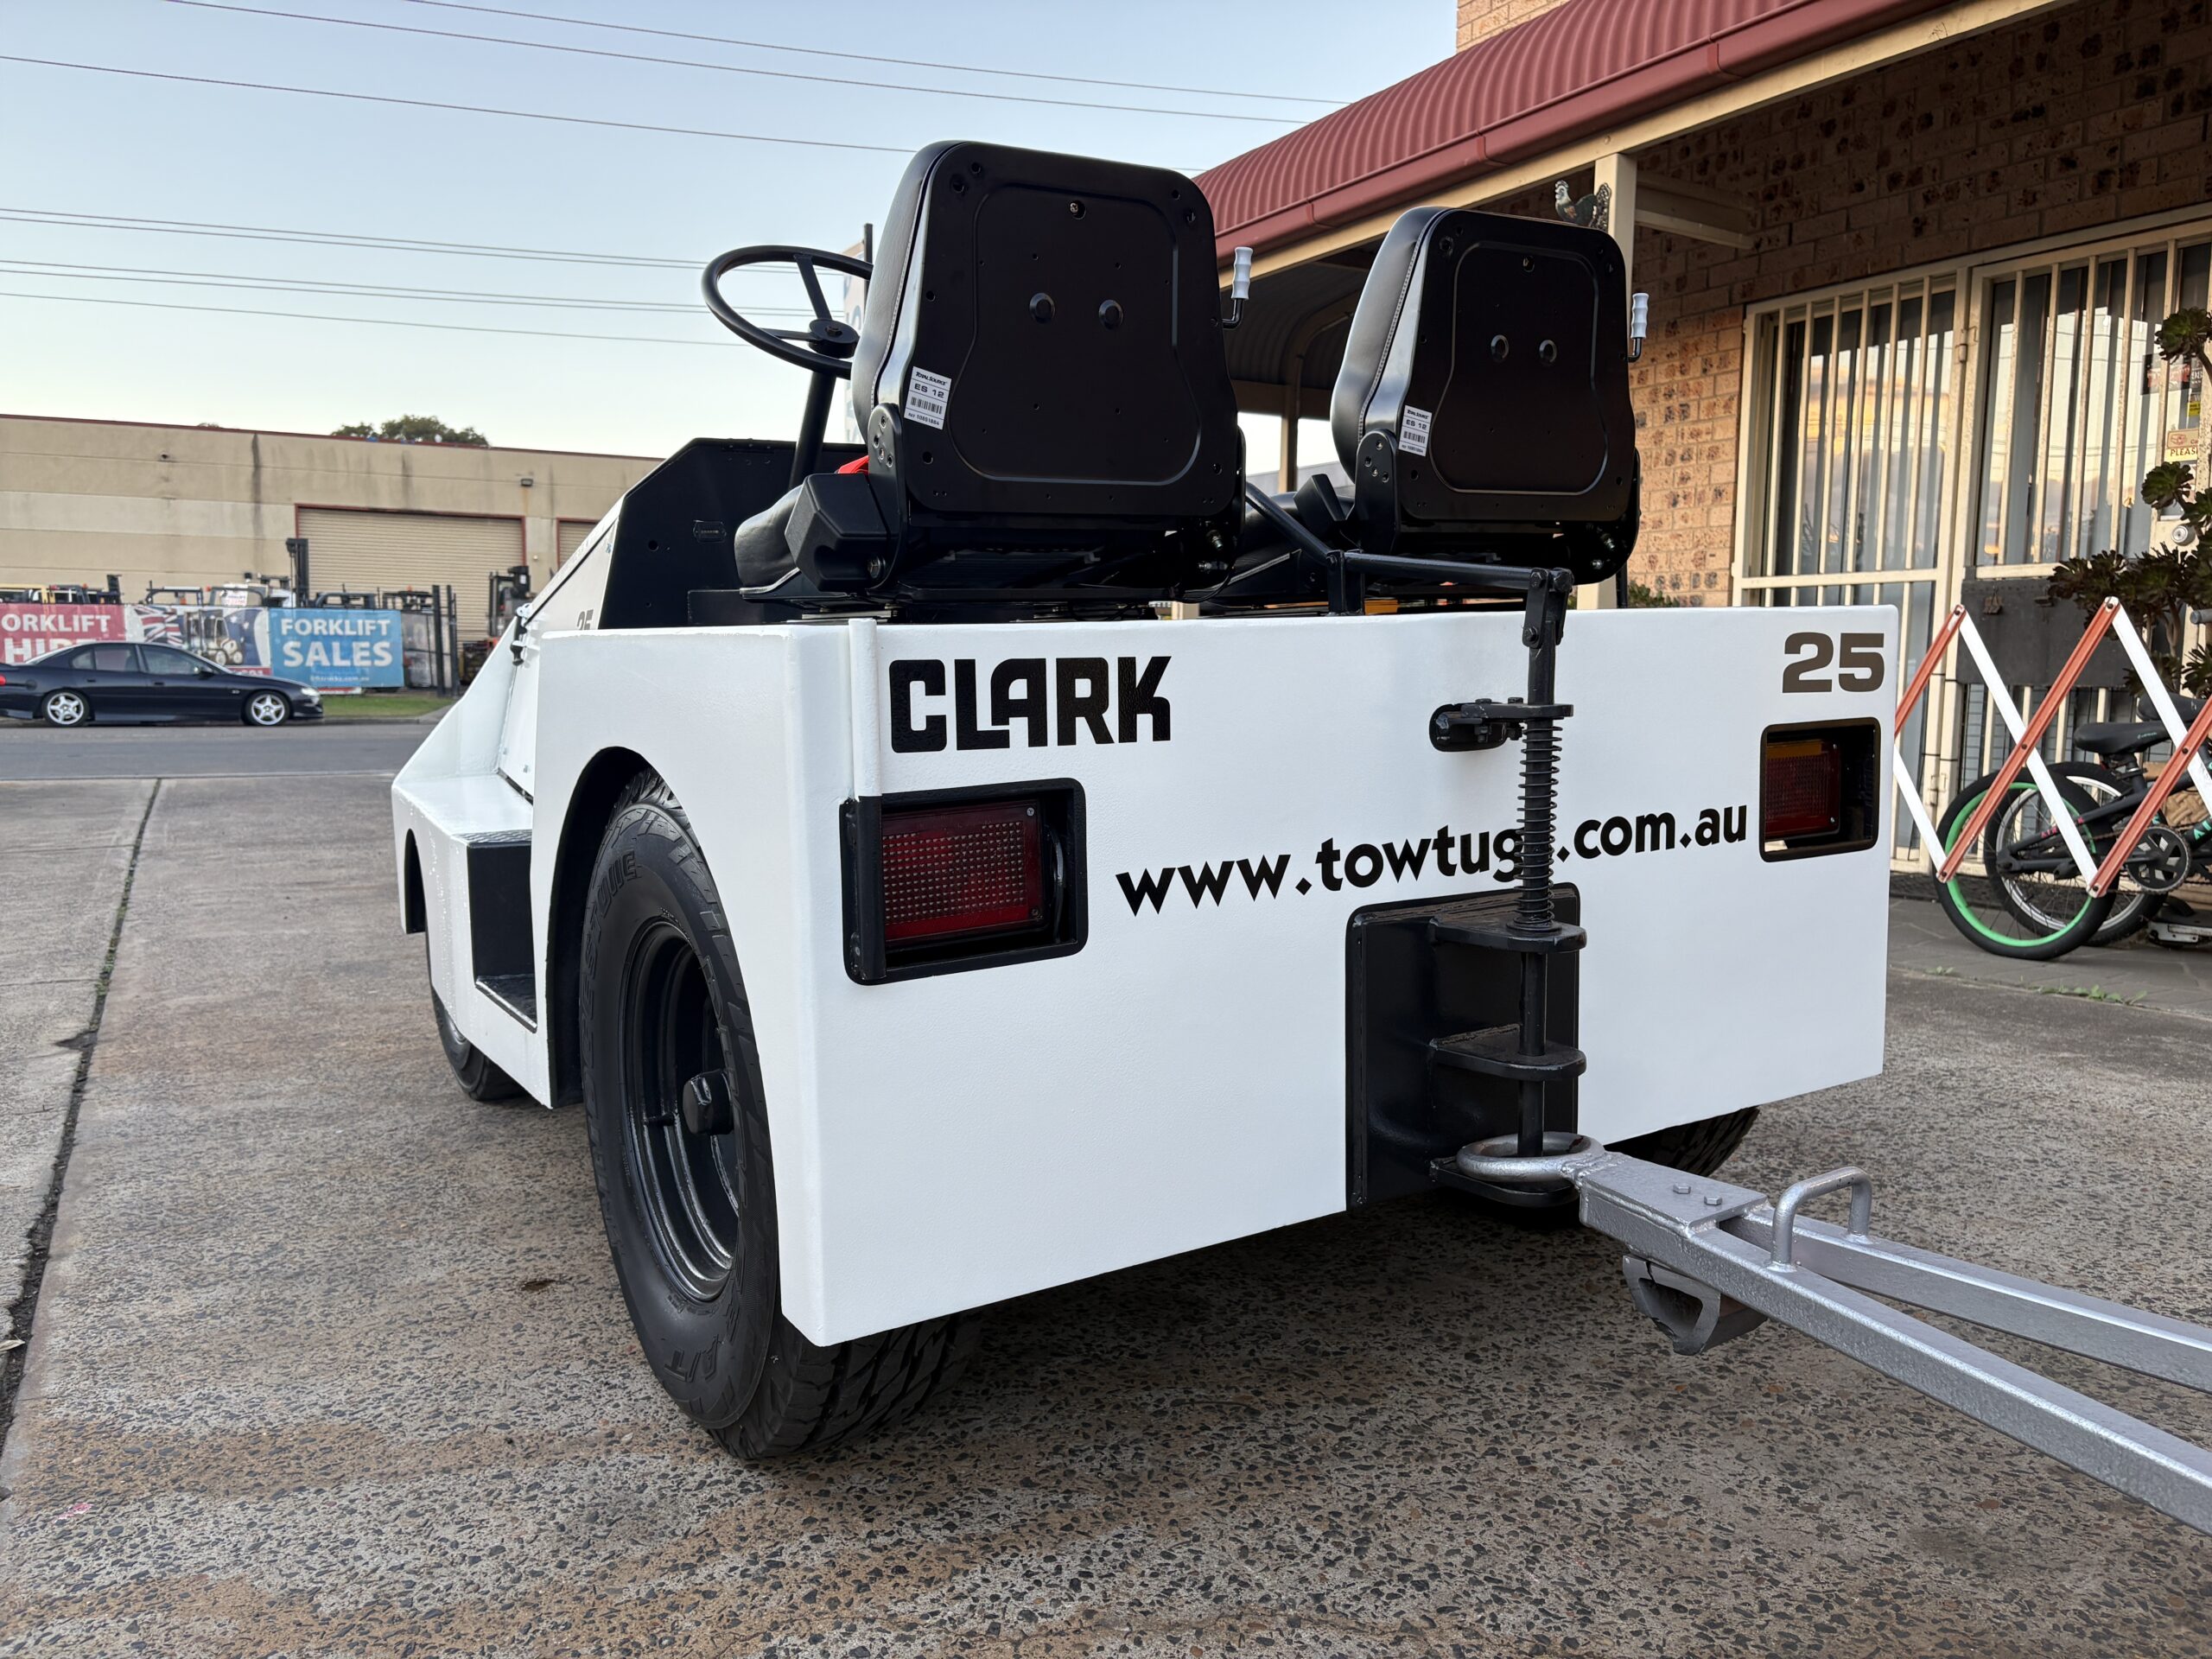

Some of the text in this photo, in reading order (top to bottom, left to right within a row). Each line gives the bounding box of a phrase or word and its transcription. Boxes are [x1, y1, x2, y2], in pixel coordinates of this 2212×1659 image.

[914, 383, 944, 398] ES 12
[2170, 448, 2198, 457] PLEAS
[0, 613, 111, 632] ORKLIFT
[281, 618, 391, 637] FORKLIFT
[283, 641, 393, 668] SALES
[1783, 632, 1885, 694] 25
[889, 656, 1173, 753] CLARK
[1116, 804, 1747, 918] www.towtug.com.au
